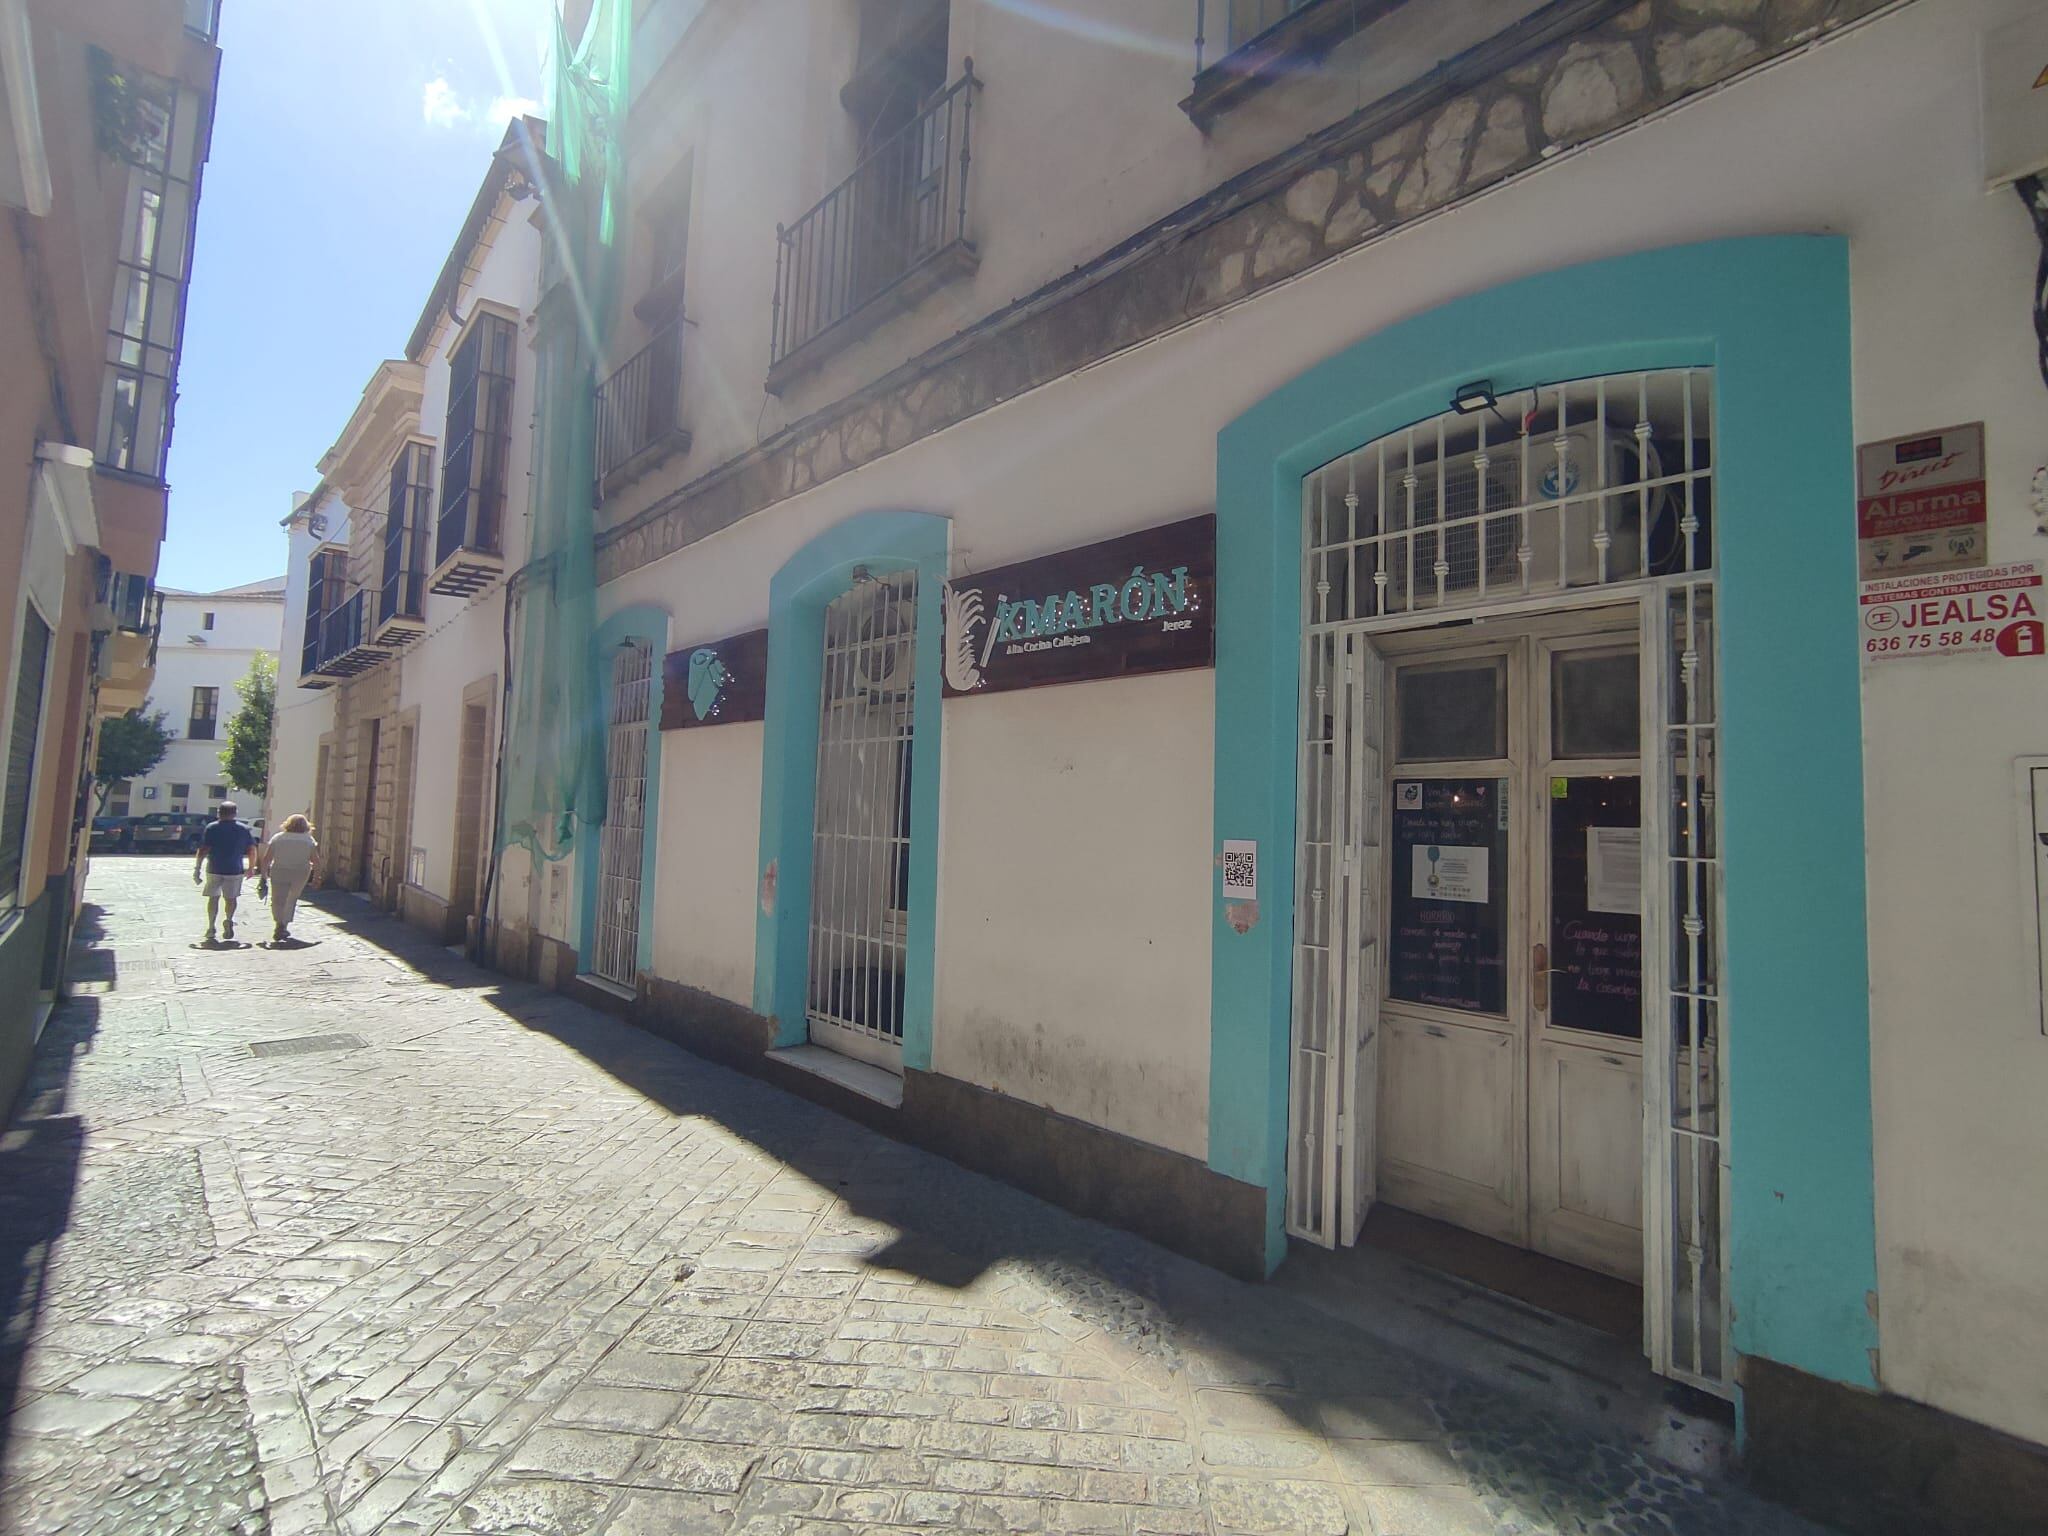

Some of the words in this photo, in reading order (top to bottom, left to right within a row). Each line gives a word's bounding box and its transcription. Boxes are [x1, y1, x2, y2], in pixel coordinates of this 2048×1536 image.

[1878, 451, 1967, 490] Direct
[1864, 490, 1980, 520] Alarma
[1865, 576, 1939, 592] INSTALACIONES
[1943, 566, 2008, 583] PROTEGIDAS
[2011, 564, 2034, 574] POR
[1867, 591, 1918, 603] SISTEMAS
[1921, 584, 1966, 597] CONTRA
[1968, 578, 2032, 591] INCENDIOS
[997, 565, 1188, 642] KMARÓN
[1902, 592, 2036, 628] JEALSA
[1161, 618, 1192, 632] Jerez
[1866, 637, 1900, 652] 636
[1907, 634, 1931, 648] 75
[1938, 631, 1963, 645] 58
[1970, 628, 1995, 643] 48
[1420, 911, 1455, 922] HORARIO
